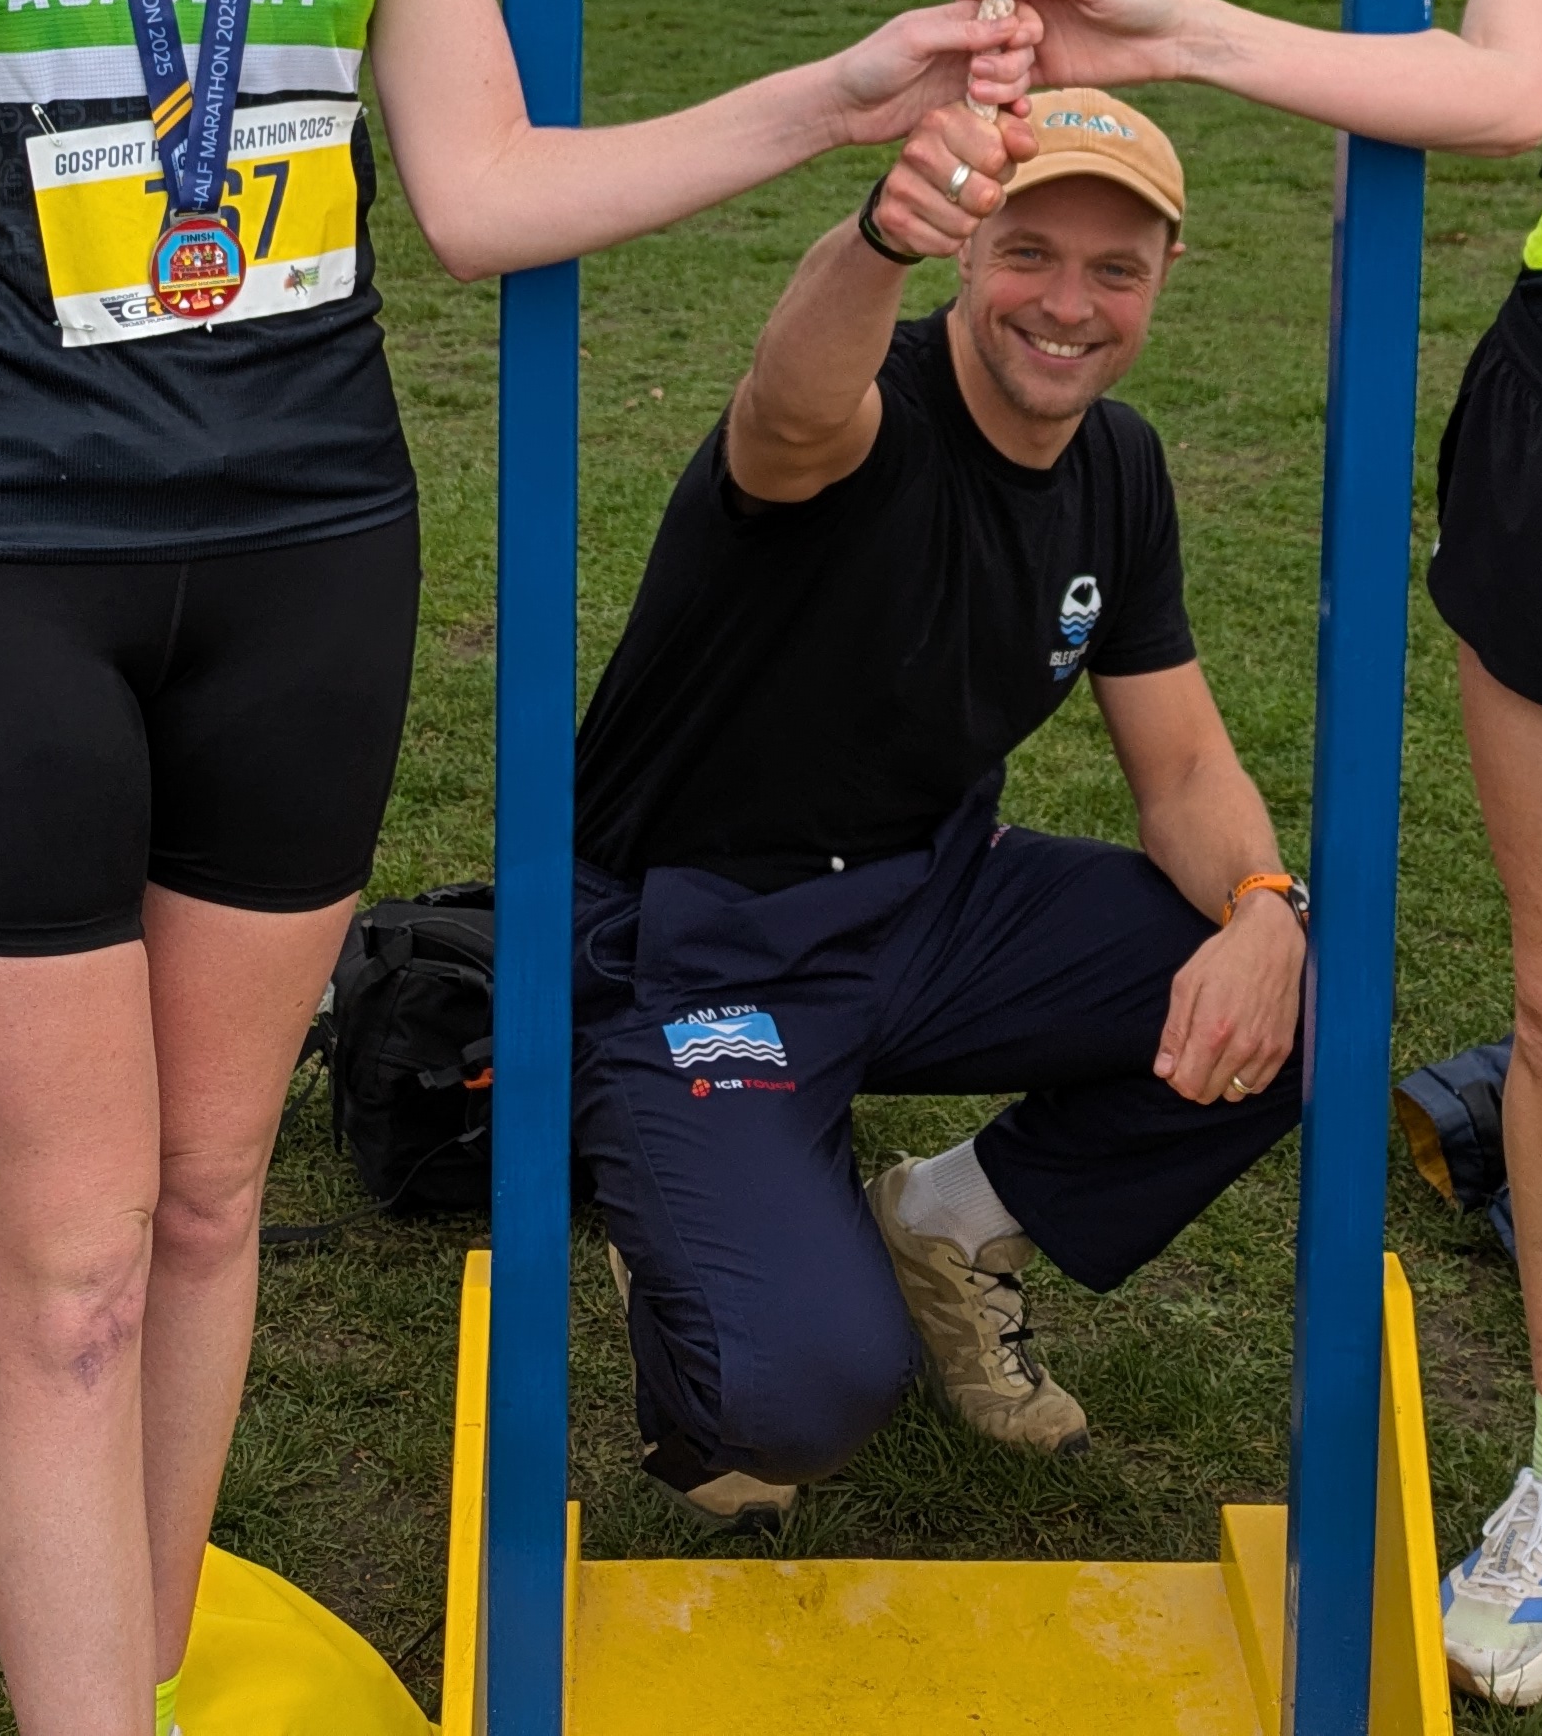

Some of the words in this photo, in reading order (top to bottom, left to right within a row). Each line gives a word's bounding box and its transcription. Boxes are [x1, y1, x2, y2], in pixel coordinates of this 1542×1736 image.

[148, 27, 173, 77] 2025
[202, 44, 229, 160] MARATHON
[55, 142, 143, 176] GOSPORT
[229, 119, 296, 152] RATHON
[300, 115, 337, 141] 2025
[192, 161, 214, 210] HALF
[181, 232, 215, 243] FINISH
